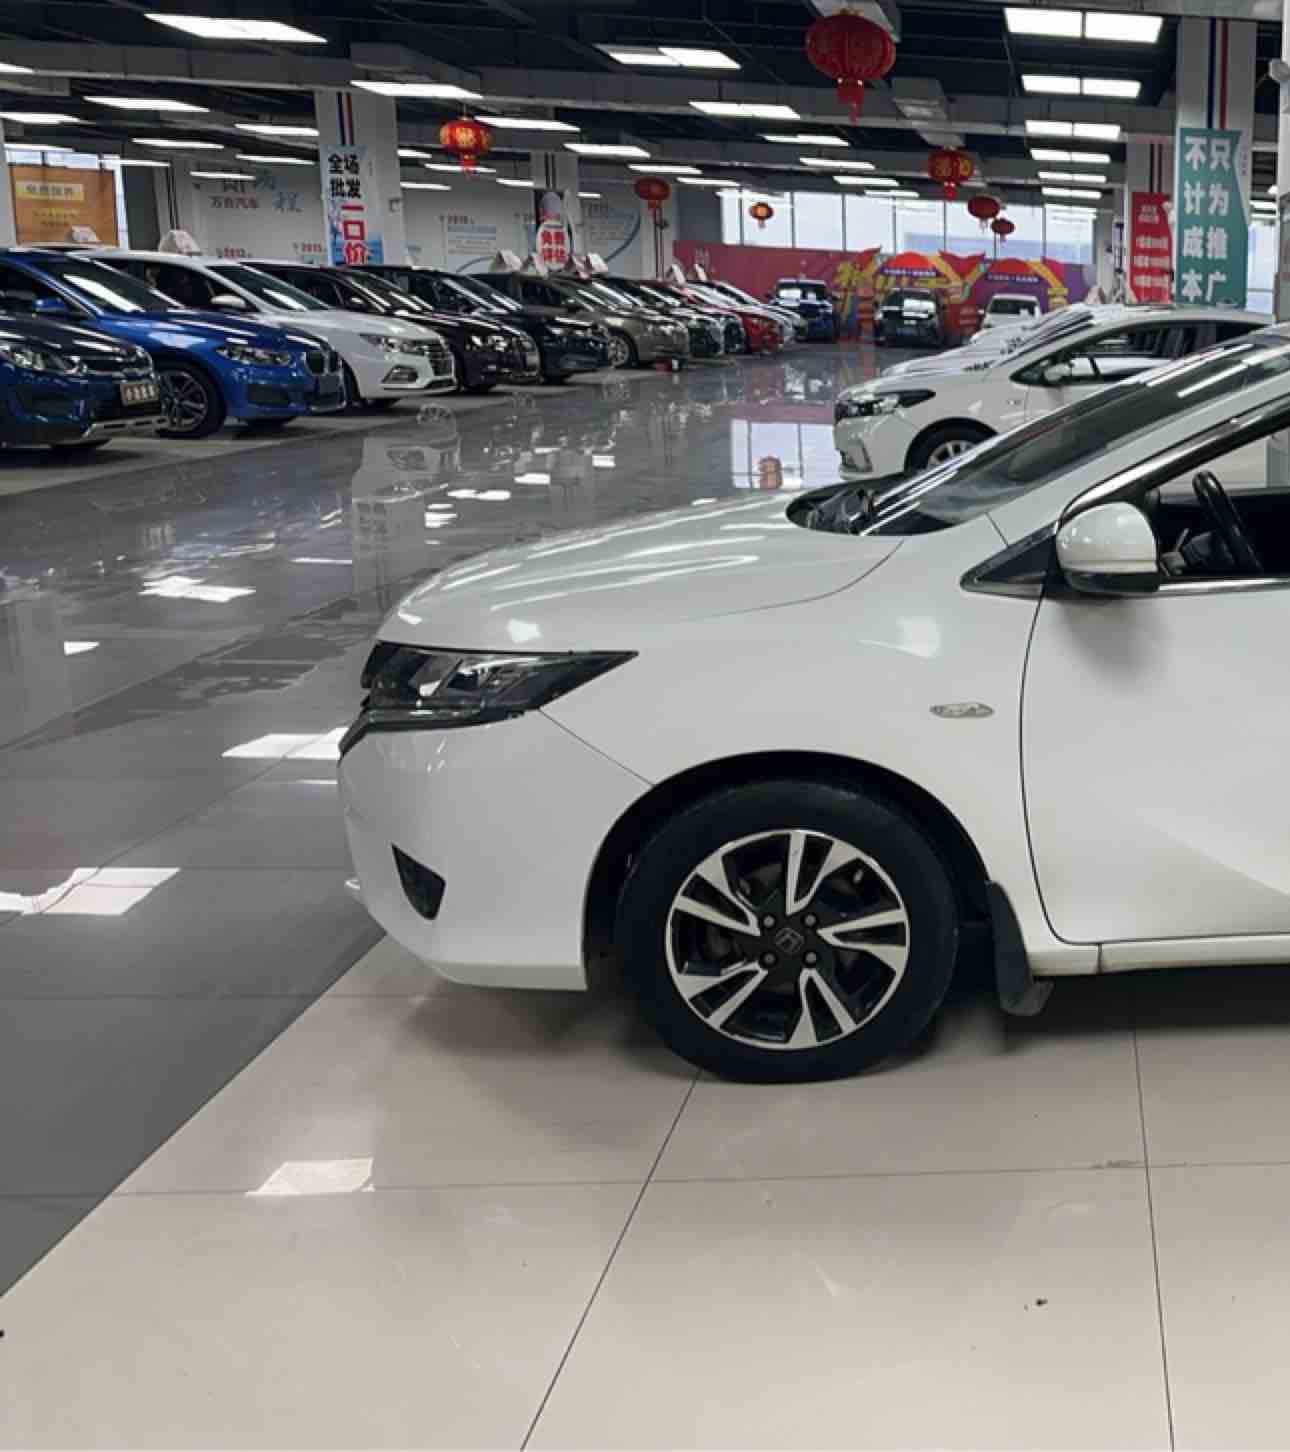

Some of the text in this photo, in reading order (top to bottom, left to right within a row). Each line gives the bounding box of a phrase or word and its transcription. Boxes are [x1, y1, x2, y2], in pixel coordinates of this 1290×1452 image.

[340, 203, 368, 265] 一口价
[1181, 136, 1208, 303] 不计成本
[1205, 138, 1232, 303] 只为推广
